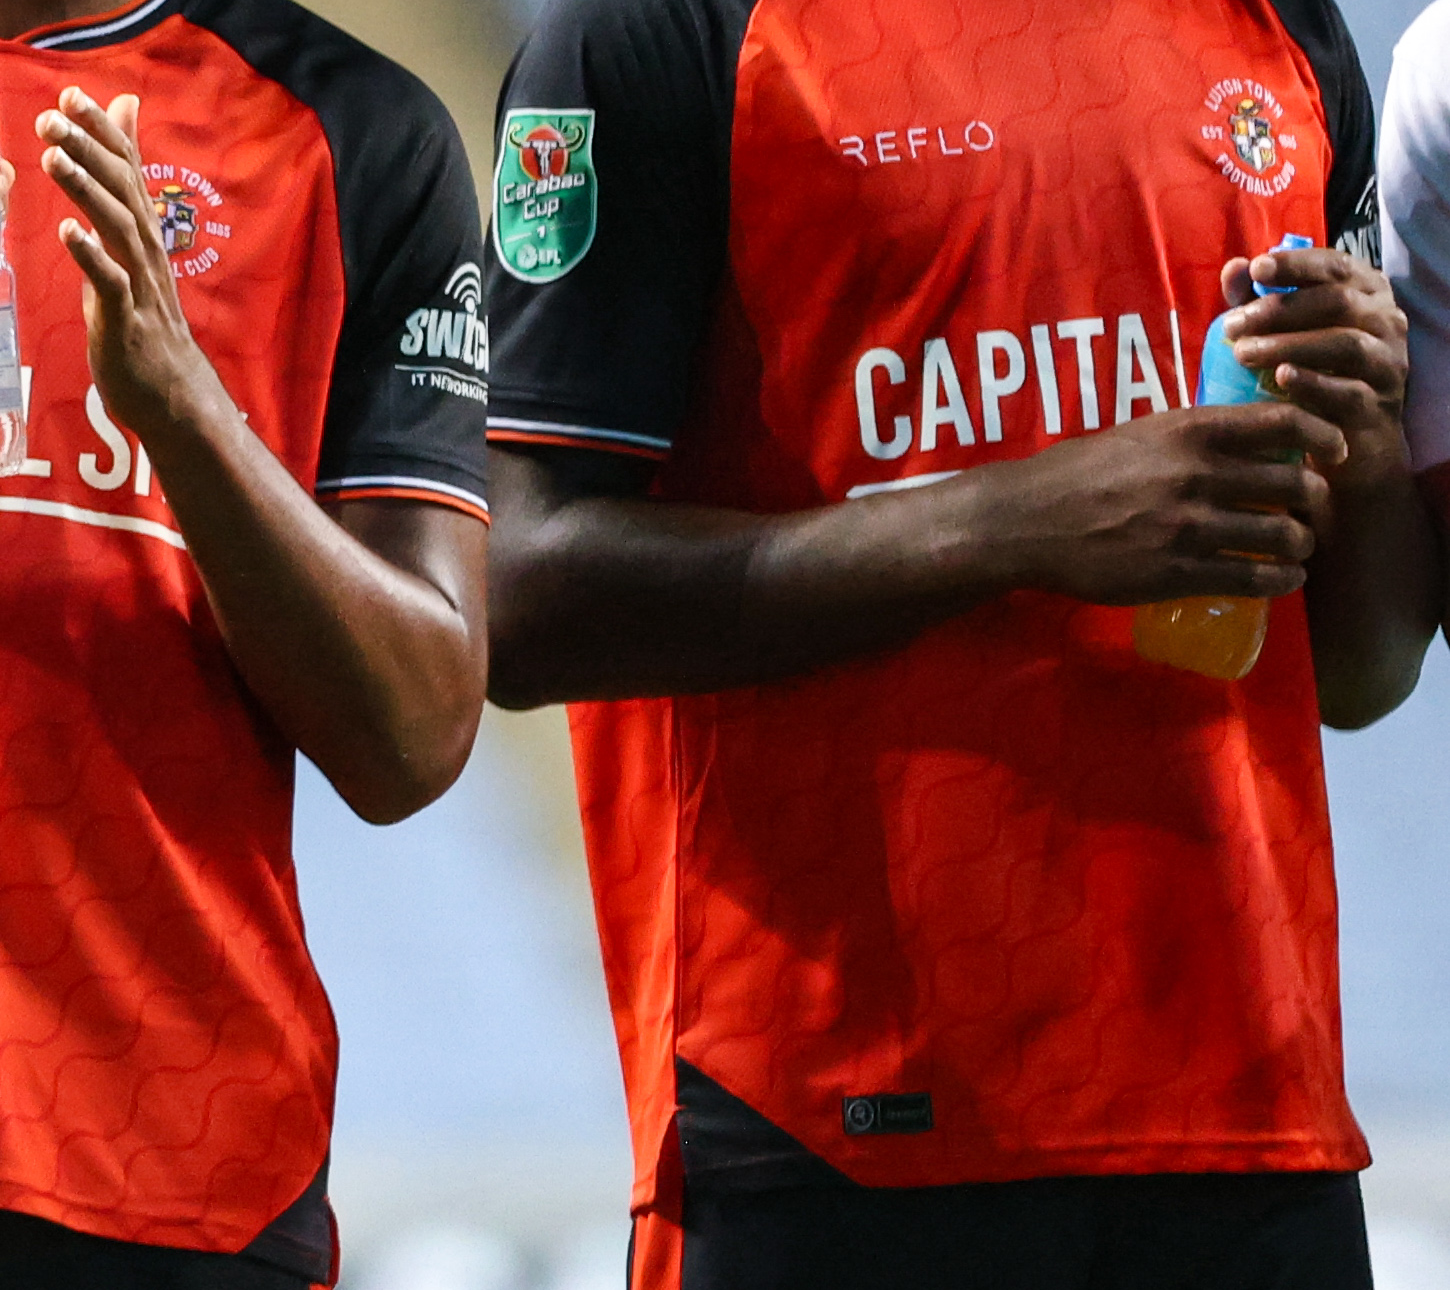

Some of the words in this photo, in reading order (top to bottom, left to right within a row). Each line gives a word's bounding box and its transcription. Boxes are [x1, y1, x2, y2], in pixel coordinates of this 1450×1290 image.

[1244, 79, 1283, 119] TOWN
[839, 120, 994, 166] REFLO
[180, 167, 222, 207] TOWN
[503, 172, 585, 204] Carabao
[523, 197, 560, 221] Cup
[184, 247, 219, 276] CLUB
[411, 373, 426, 386] IT
[855, 309, 1192, 459] CAPITA
